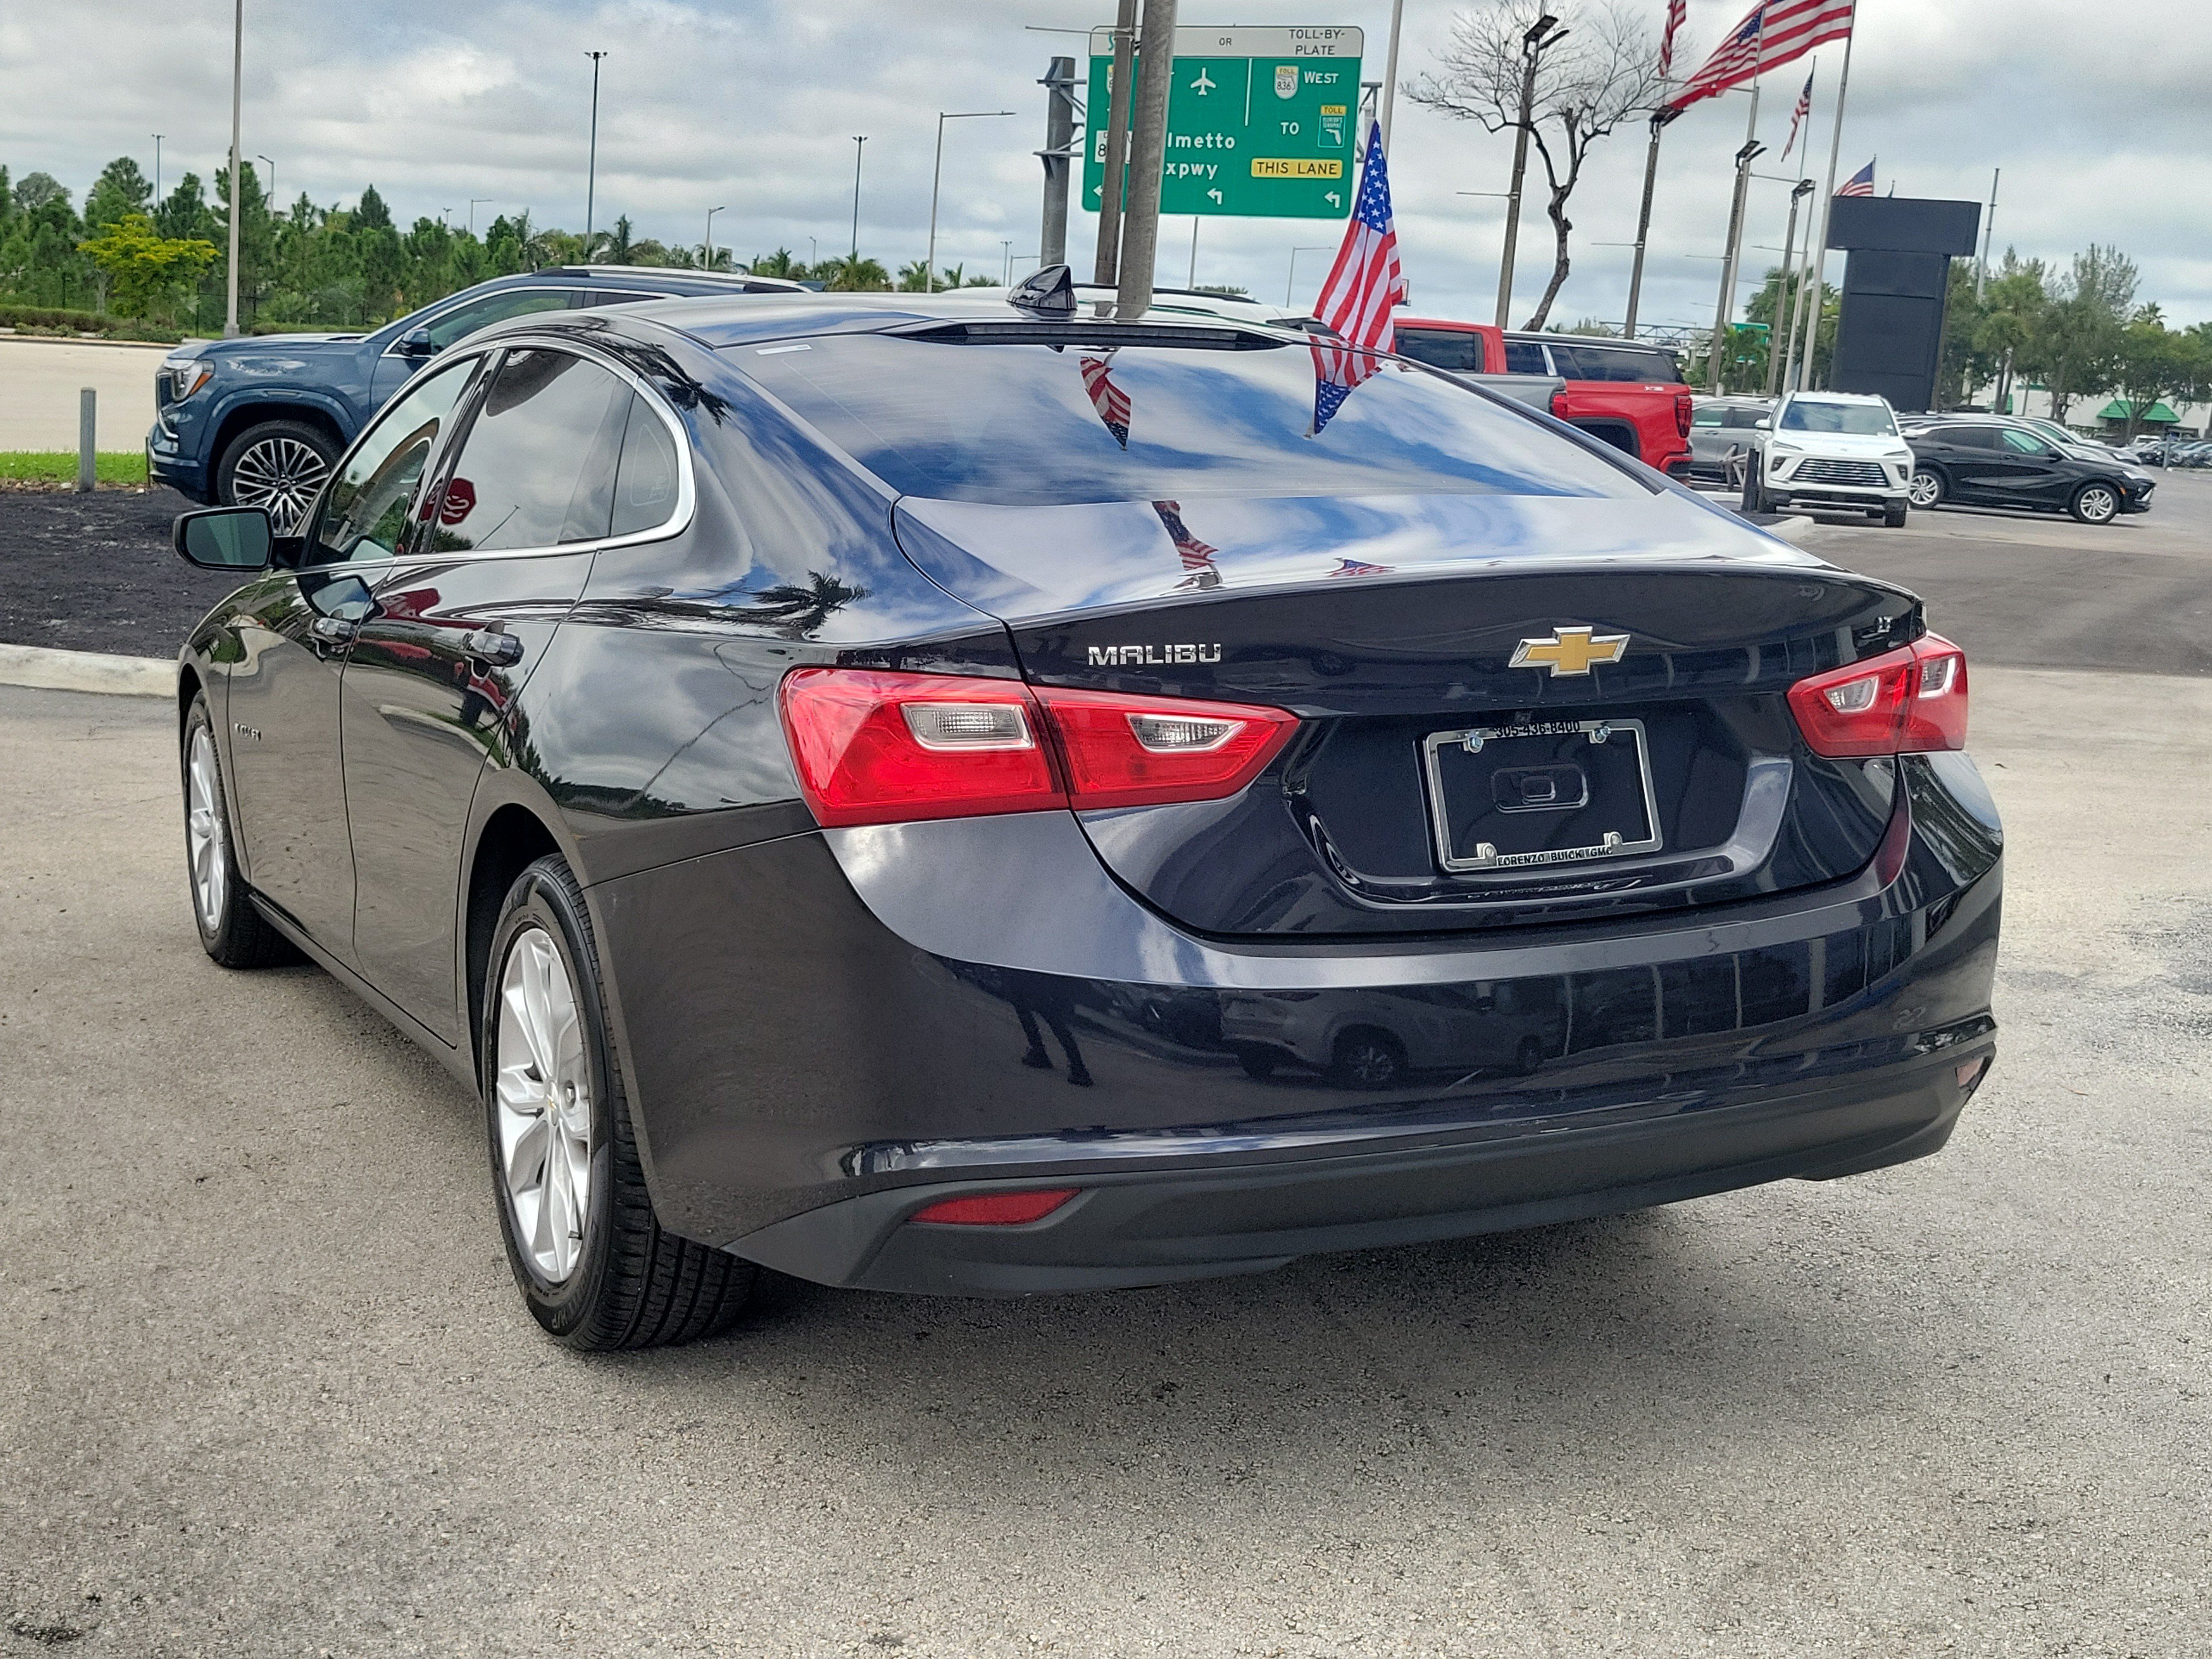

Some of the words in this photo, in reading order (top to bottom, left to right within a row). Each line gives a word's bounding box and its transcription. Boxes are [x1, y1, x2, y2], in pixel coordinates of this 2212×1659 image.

[1289, 29, 1345, 40] TOLL-BY-
[1218, 38, 1232, 46] OR
[1295, 45, 1335, 55] PLATE
[1277, 81, 1291, 91] 836
[1280, 122, 1299, 135] TO
[1167, 132, 1235, 149] lmetto
[1164, 162, 1218, 180] xpwy
[1256, 161, 1289, 174] THIS
[1297, 163, 1338, 176] LANE
[1088, 643, 1221, 665] MALIBU
[1497, 853, 1544, 866] LORENZO
[1550, 849, 1583, 861] BUICK
[1590, 847, 1613, 857] GMC
